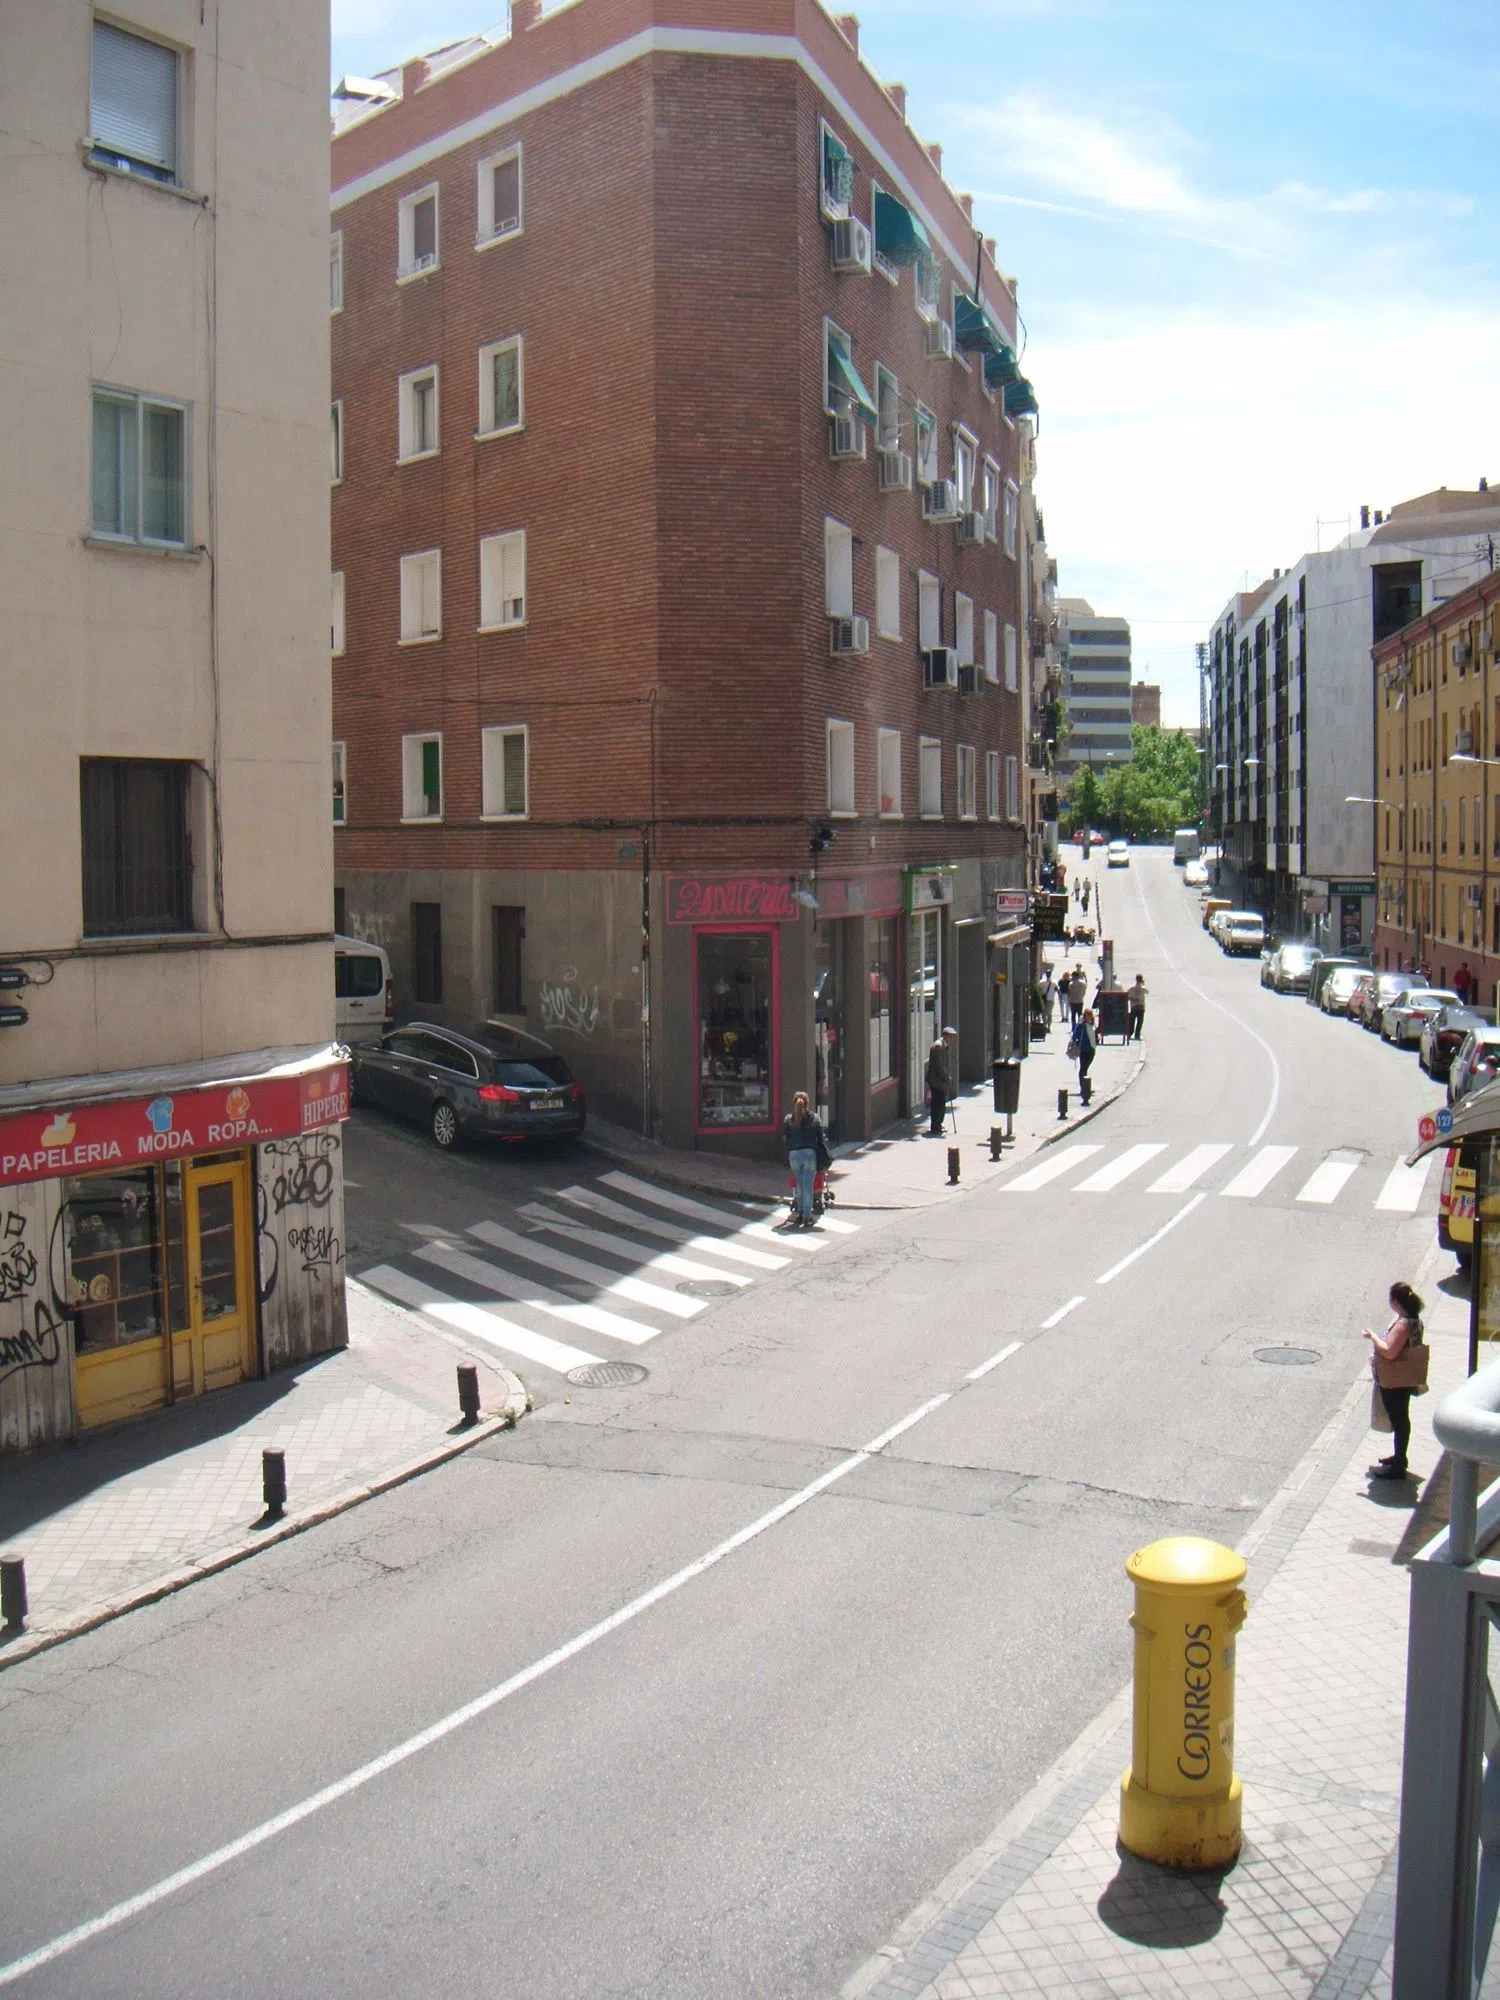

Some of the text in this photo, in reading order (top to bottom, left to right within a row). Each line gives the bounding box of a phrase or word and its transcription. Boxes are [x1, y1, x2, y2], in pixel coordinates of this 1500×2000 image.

[303, 1091, 347, 1126] HIPERE
[1437, 1116, 1452, 1128] 127
[1422, 1123, 1433, 1134] 44
[2, 1141, 122, 1175] PAPELERIA
[138, 1129, 194, 1154] MODA
[1177, 1623, 1212, 1781] CORREOS
